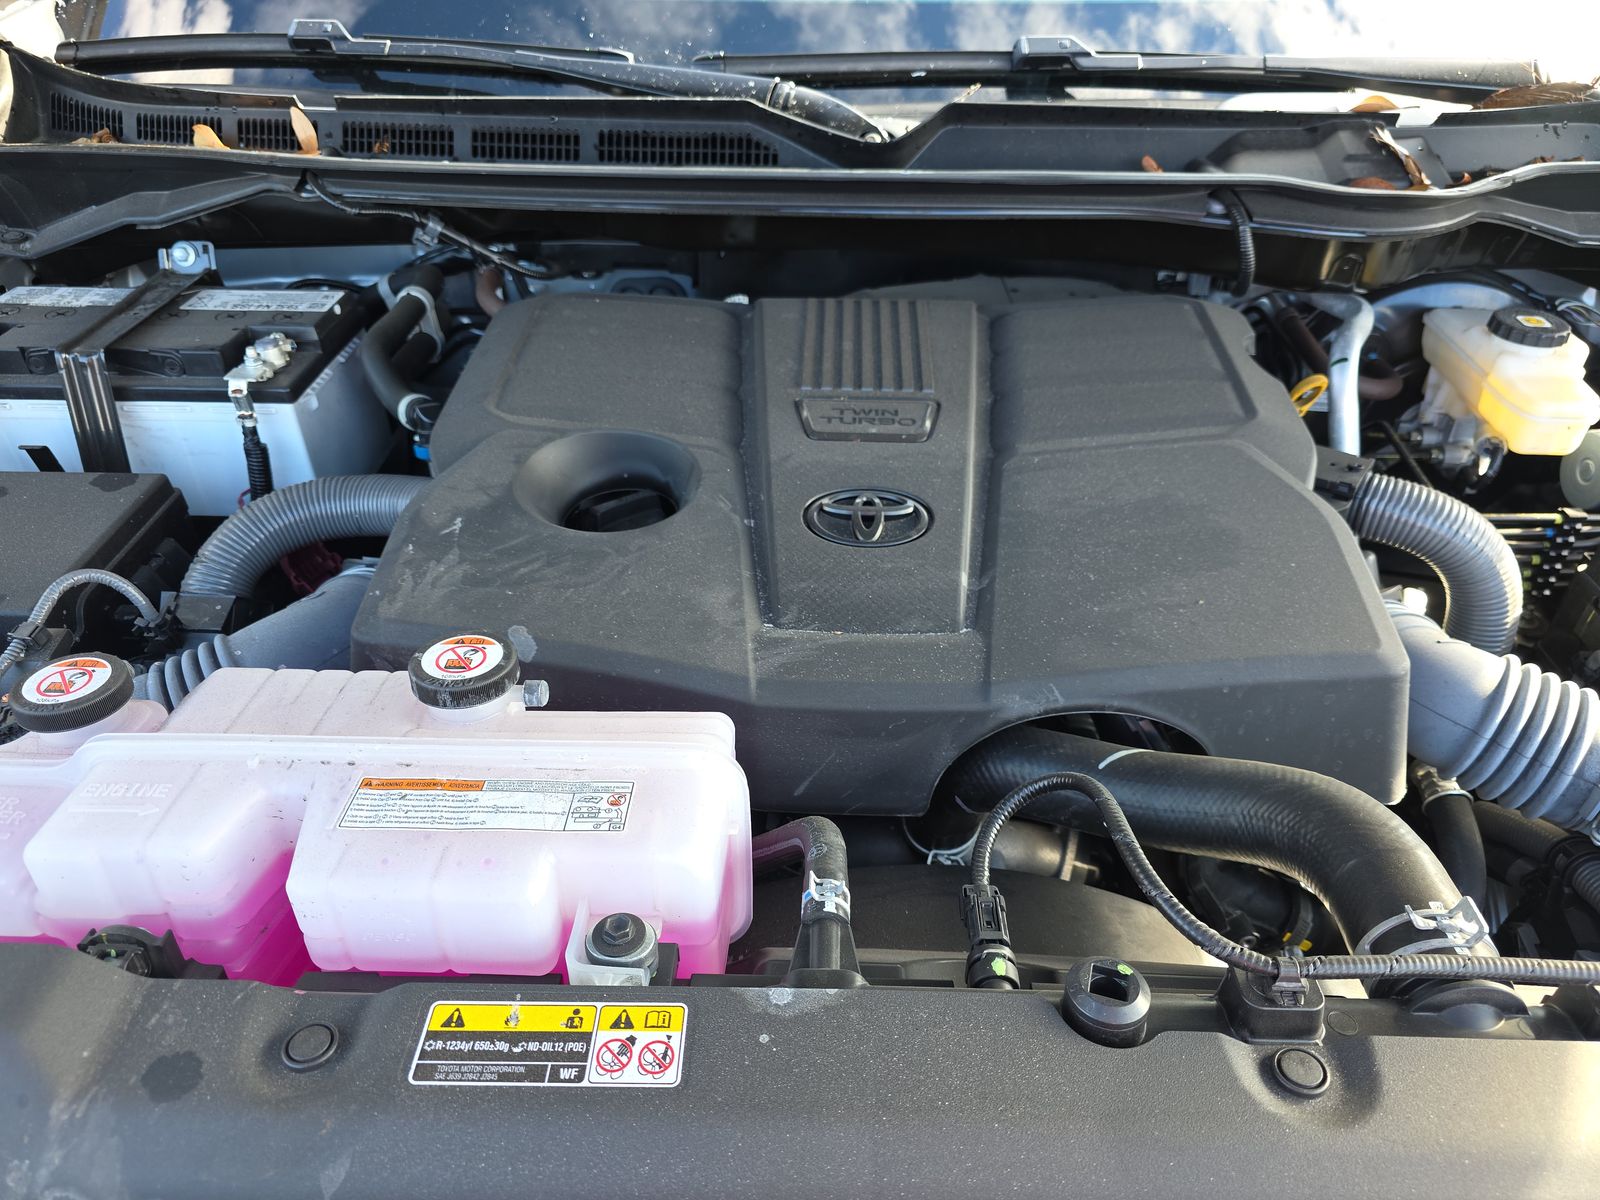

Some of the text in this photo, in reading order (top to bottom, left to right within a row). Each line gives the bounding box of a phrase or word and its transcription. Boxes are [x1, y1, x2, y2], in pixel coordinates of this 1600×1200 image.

[832, 407, 899, 417] TWIN
[819, 417, 917, 426] TURBO
[80, 783, 173, 798] ENGINE
[461, 1065, 482, 1073] MOTOR
[483, 1065, 526, 1073] CORPORATION
[559, 1067, 579, 1080] WF
